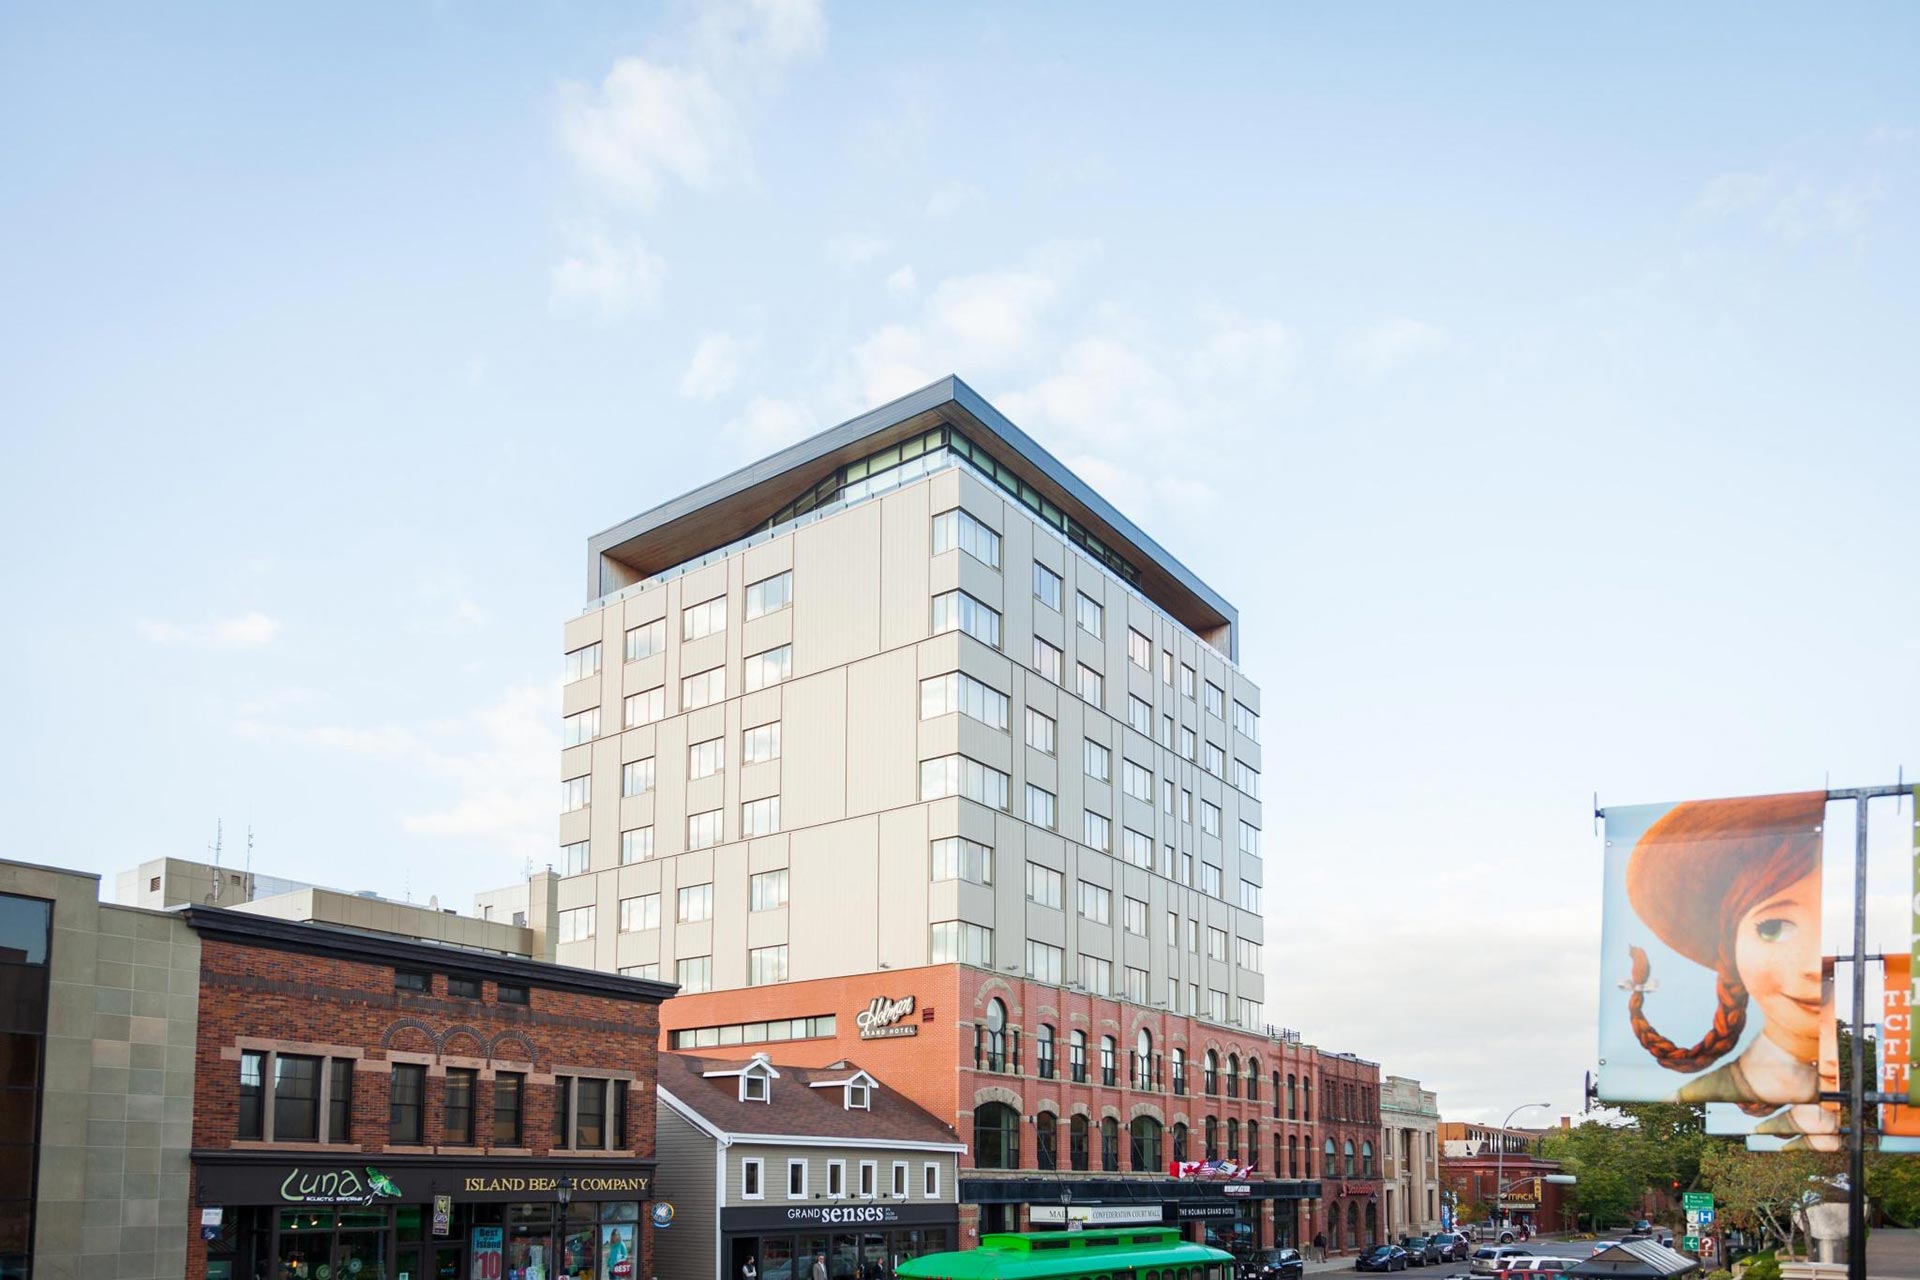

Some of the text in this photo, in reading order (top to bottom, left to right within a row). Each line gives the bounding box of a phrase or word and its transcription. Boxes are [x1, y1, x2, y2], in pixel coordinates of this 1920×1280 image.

[889, 1026, 914, 1034] HOTEL
[281, 1168, 362, 1201] Luna
[465, 1178, 648, 1191] ISLAND BEAH COMPANY
[787, 1208, 820, 1219] GRAND
[821, 1206, 884, 1223] senses
[1700, 1211, 1712, 1223] H
